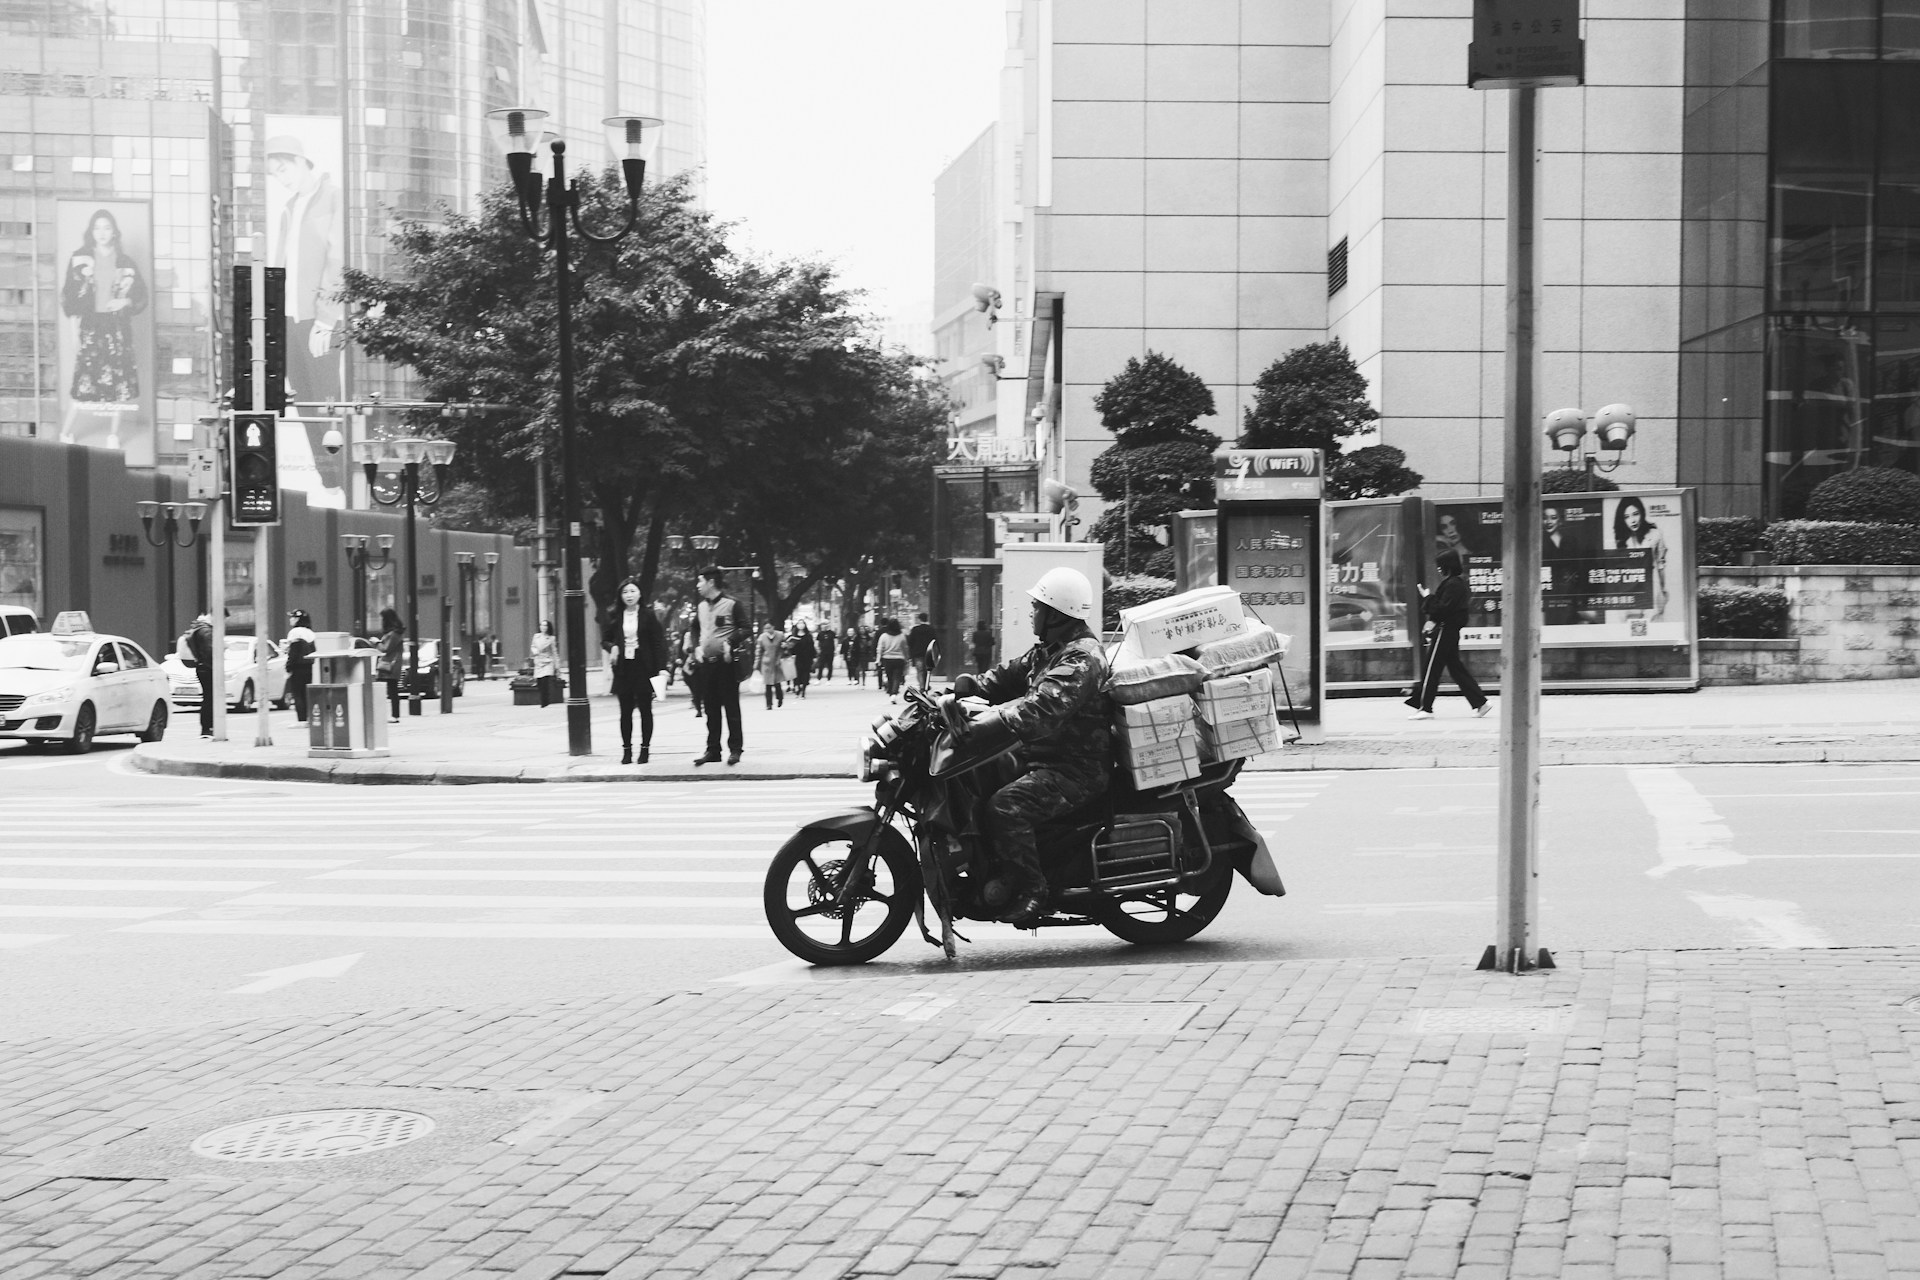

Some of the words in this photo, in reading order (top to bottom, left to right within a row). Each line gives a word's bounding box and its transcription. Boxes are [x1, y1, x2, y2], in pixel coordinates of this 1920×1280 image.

[1269, 458, 1299, 470] WiFi
[1235, 564, 1305, 578] 国家有力量
[1606, 574, 1622, 584] OF
[1622, 574, 1646, 583] LIFE
